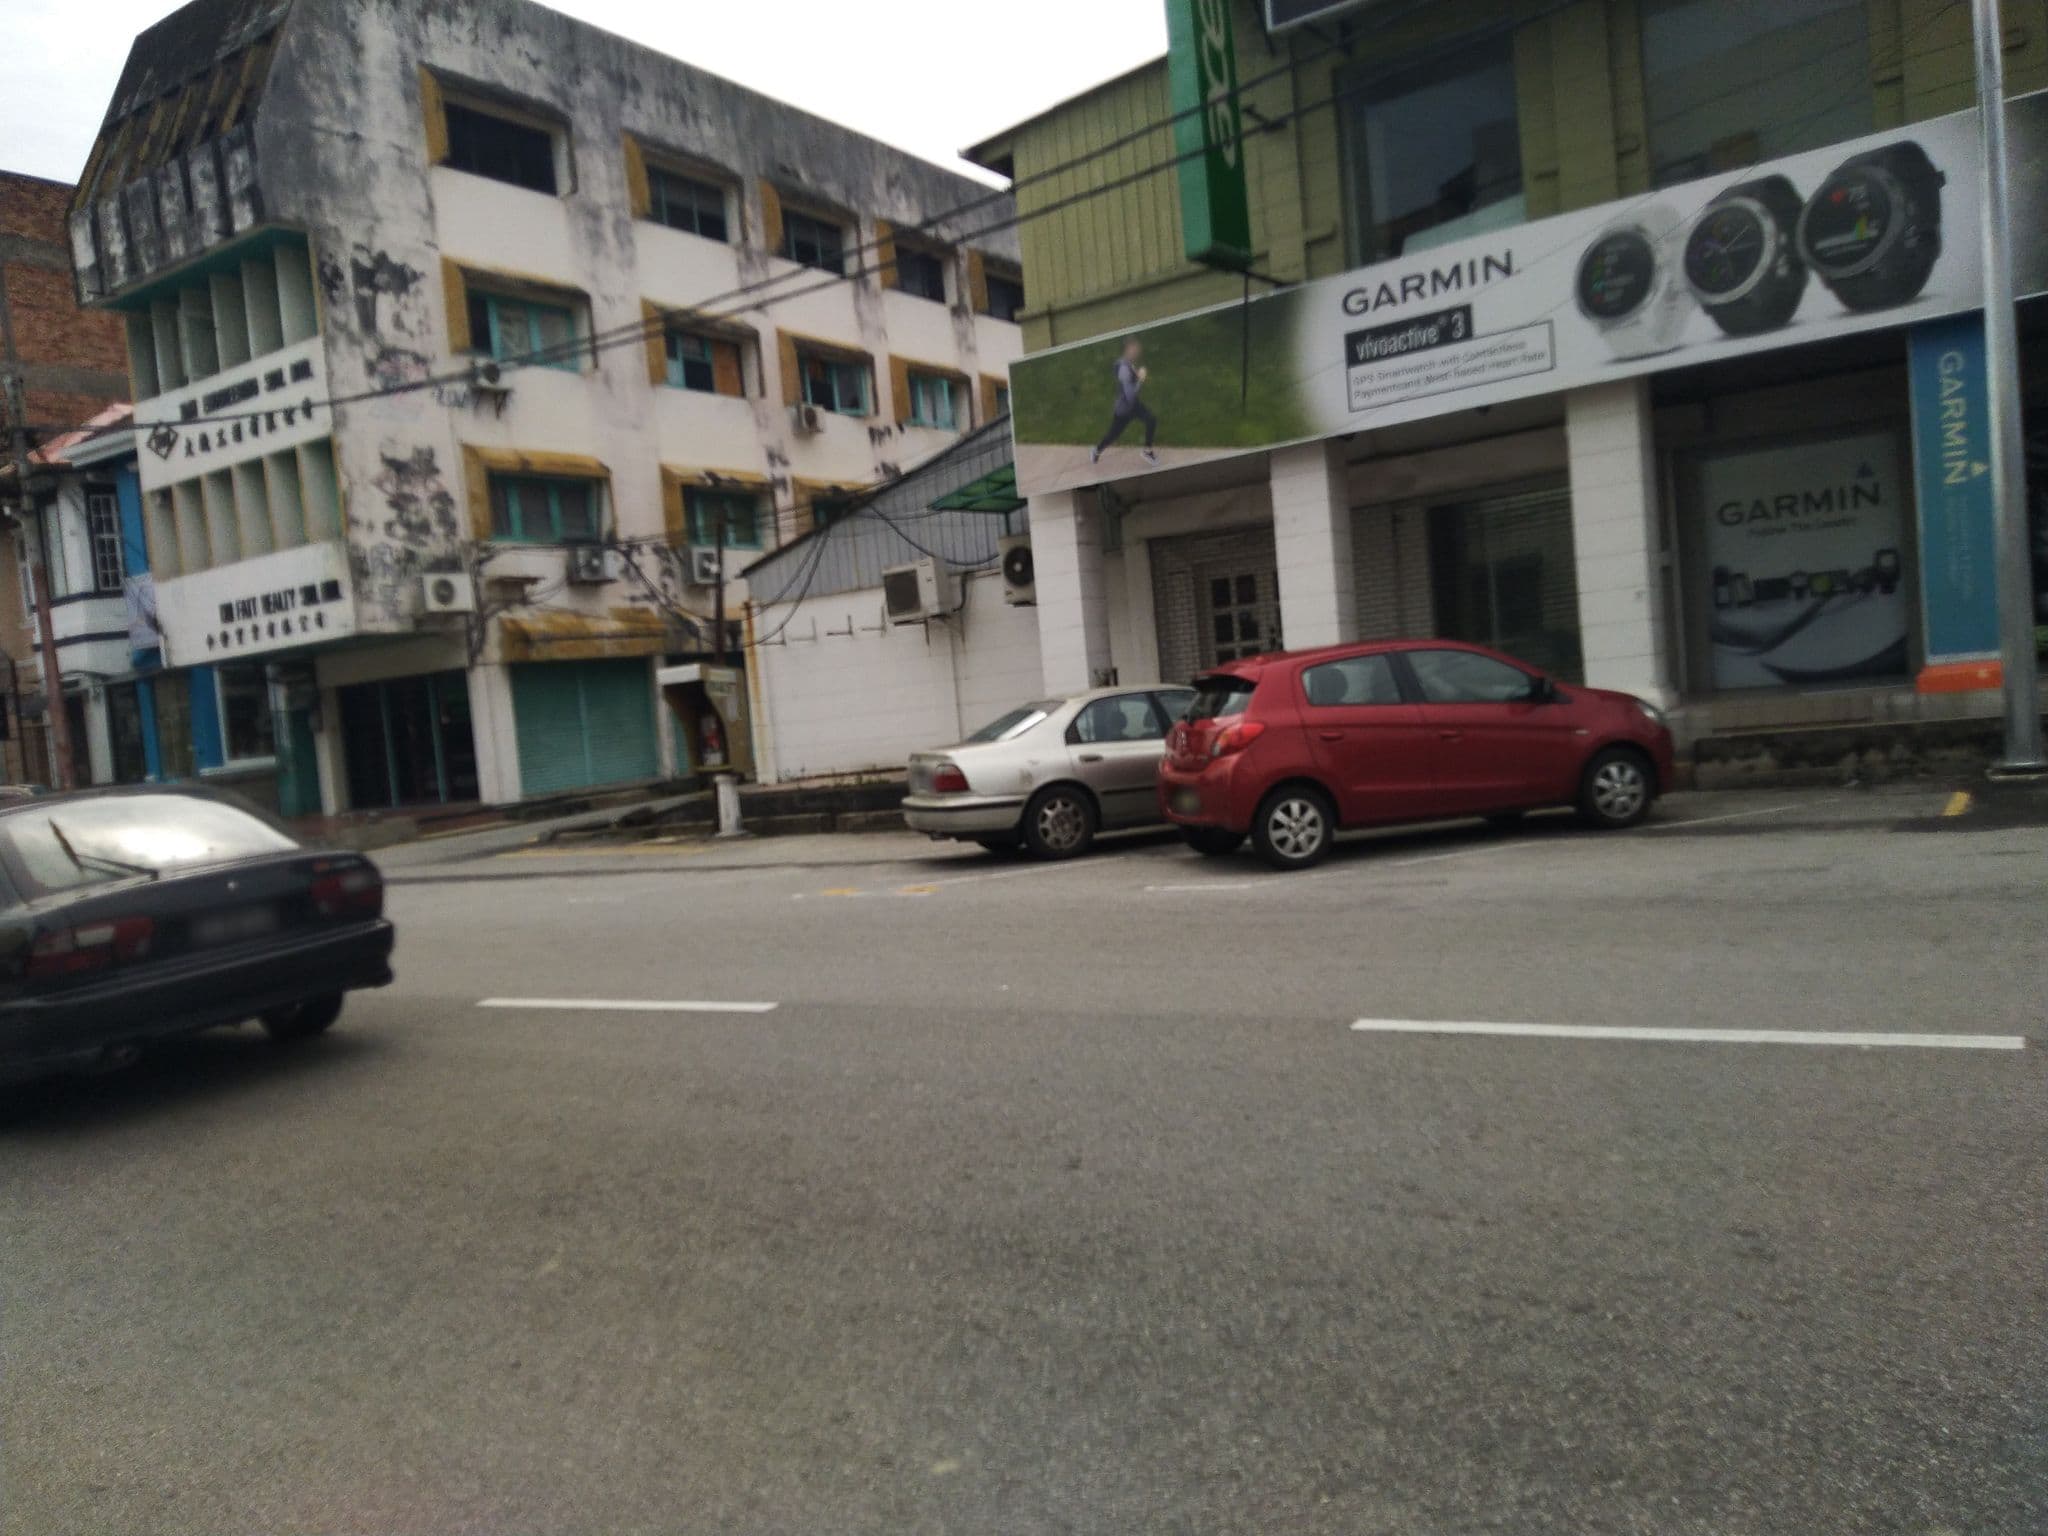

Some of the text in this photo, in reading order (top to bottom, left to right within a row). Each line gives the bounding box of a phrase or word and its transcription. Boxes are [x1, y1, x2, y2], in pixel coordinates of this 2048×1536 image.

[1342, 248, 1514, 317] GARMIN
[1450, 310, 1466, 341] 3
[1938, 350, 1968, 485] GARMIN
[1717, 482, 1881, 527] GARMIN
